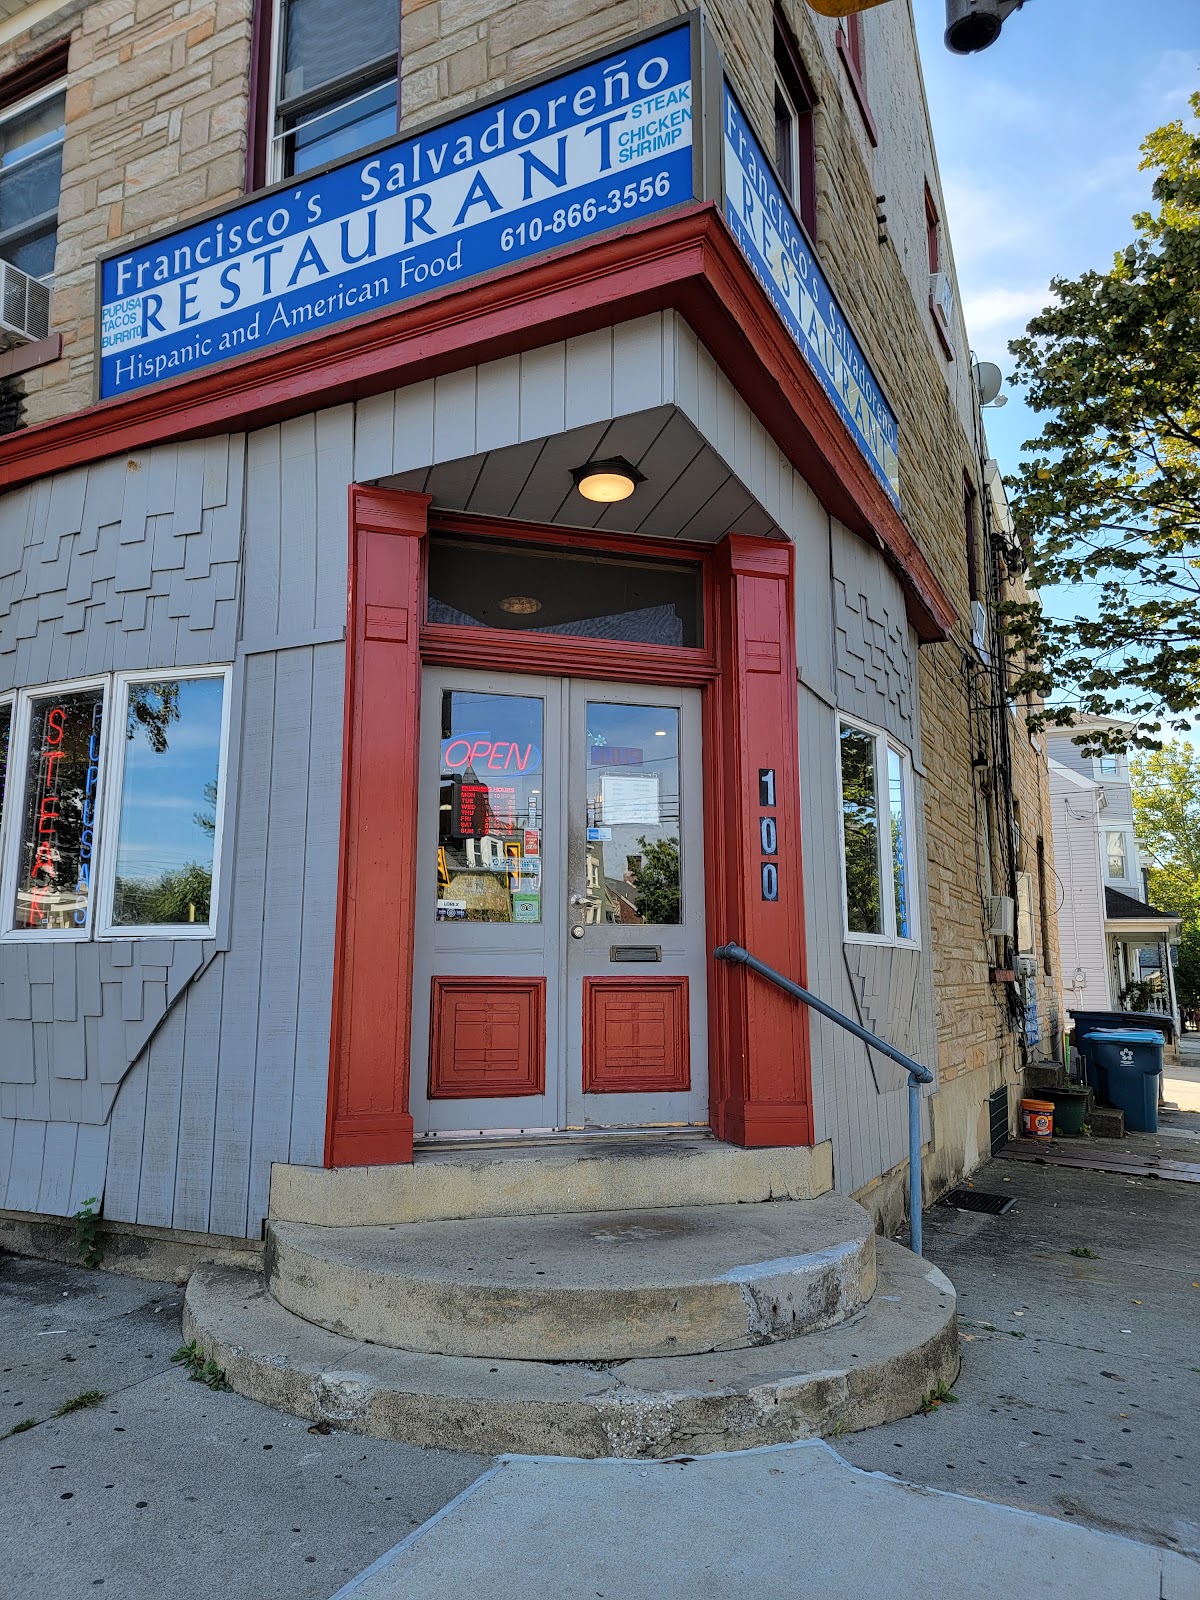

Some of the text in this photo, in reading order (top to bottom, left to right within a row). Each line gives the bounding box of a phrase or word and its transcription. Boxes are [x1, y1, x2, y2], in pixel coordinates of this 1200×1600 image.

[618, 106, 692, 147] CHICKEN
[631, 85, 690, 119] STEAK
[117, 56, 669, 296] Francisco's Salvadoreño
[618, 127, 682, 163] SHRIMP
[141, 110, 628, 339] RESTAURANT
[500, 171, 671, 251] 610-866-3556
[101, 325, 141, 348] BURRITO
[102, 297, 141, 320] PUPUSA
[102, 312, 137, 333] TACOS
[115, 239, 463, 385] Hispanic and American Food
[742, 171, 890, 471] RESTAURANT
[829, 302, 894, 443] Salvadoreño
[445, 740, 532, 770] OPEN
[30, 708, 67, 926] STEAK
[761, 771, 777, 900] 100
